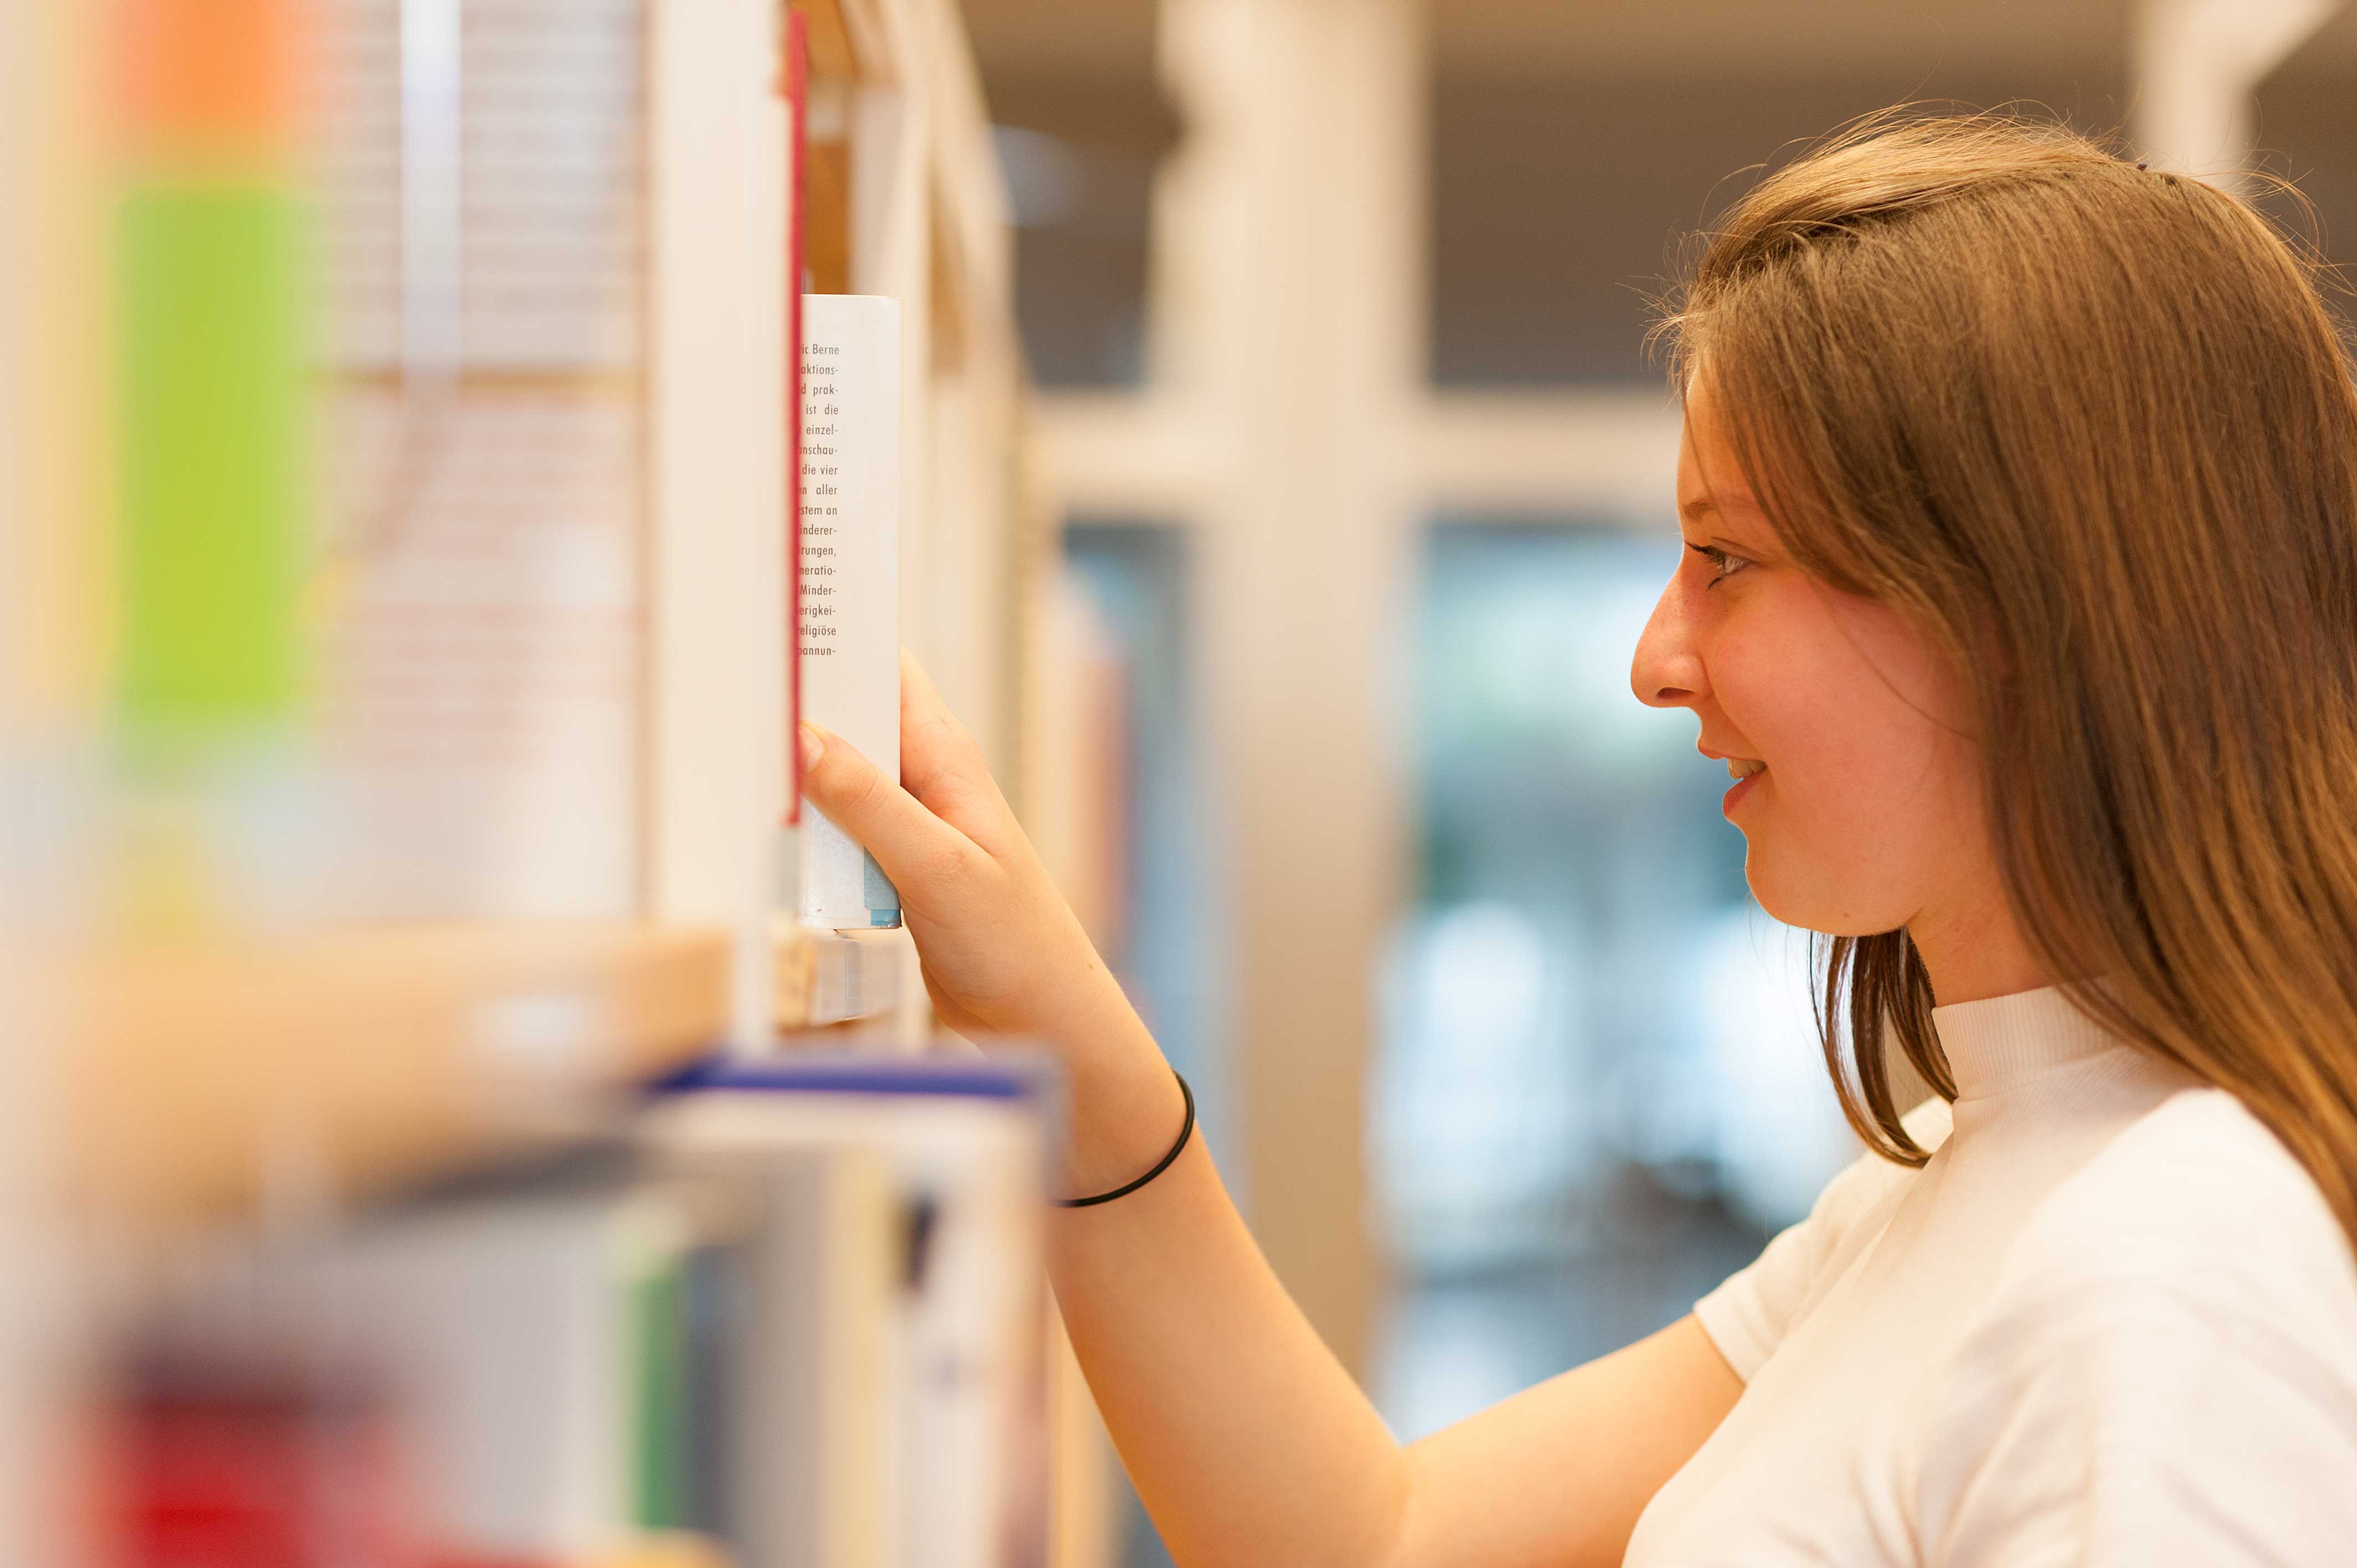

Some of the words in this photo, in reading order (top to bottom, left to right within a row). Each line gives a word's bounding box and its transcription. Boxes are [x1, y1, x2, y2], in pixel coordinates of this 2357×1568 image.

[813, 344, 839, 354] Berne
[801, 363, 838, 374] aktions-
[801, 383, 806, 394] d
[814, 384, 838, 396] prak-
[806, 405, 816, 414] ist
[825, 404, 838, 415] die
[806, 424, 838, 435] einzel-
[802, 463, 816, 474] die
[820, 465, 837, 474] vier
[816, 484, 837, 495] aller
[799, 506, 822, 515] stem
[800, 524, 836, 535] inderer-
[799, 545, 836, 558] rungen,
[799, 565, 836, 575] neratio-
[800, 584, 836, 595] Minder-
[799, 604, 836, 617] erigkei-
